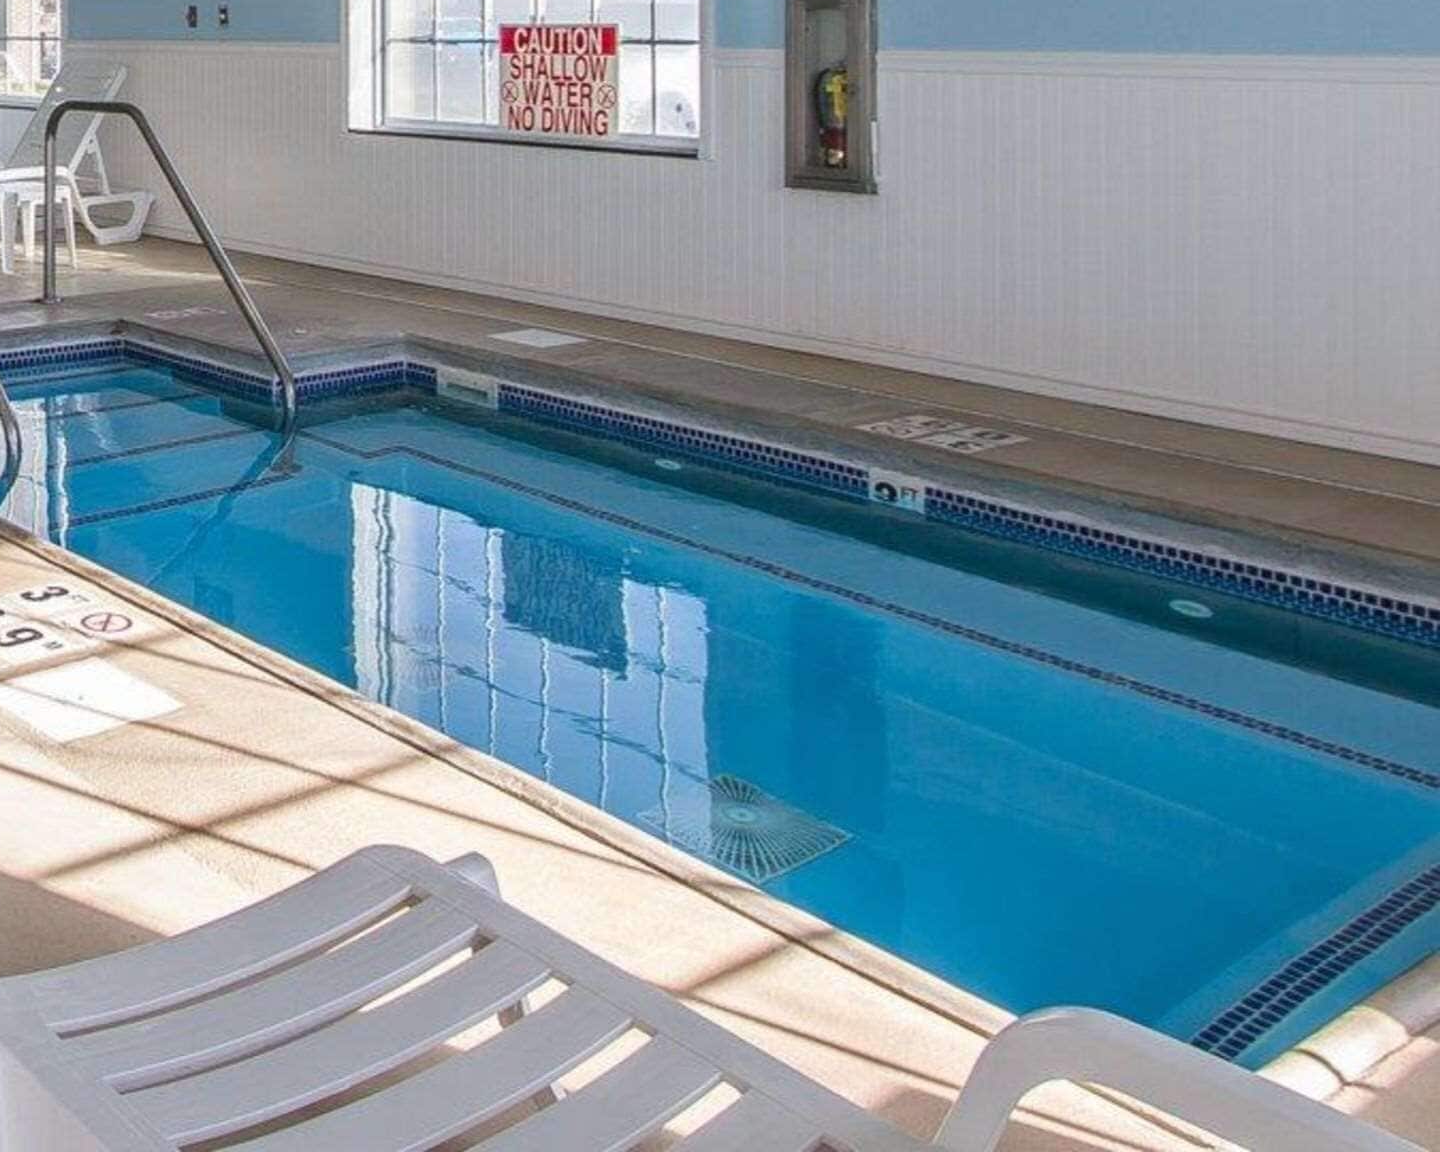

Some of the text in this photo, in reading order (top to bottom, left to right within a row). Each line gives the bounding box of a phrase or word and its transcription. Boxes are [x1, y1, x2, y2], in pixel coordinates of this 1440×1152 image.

[513, 28, 602, 54] CAUTION
[510, 56, 607, 82] SHALLOW
[523, 81, 593, 107] WATER
[509, 107, 608, 136] NO DIVING
